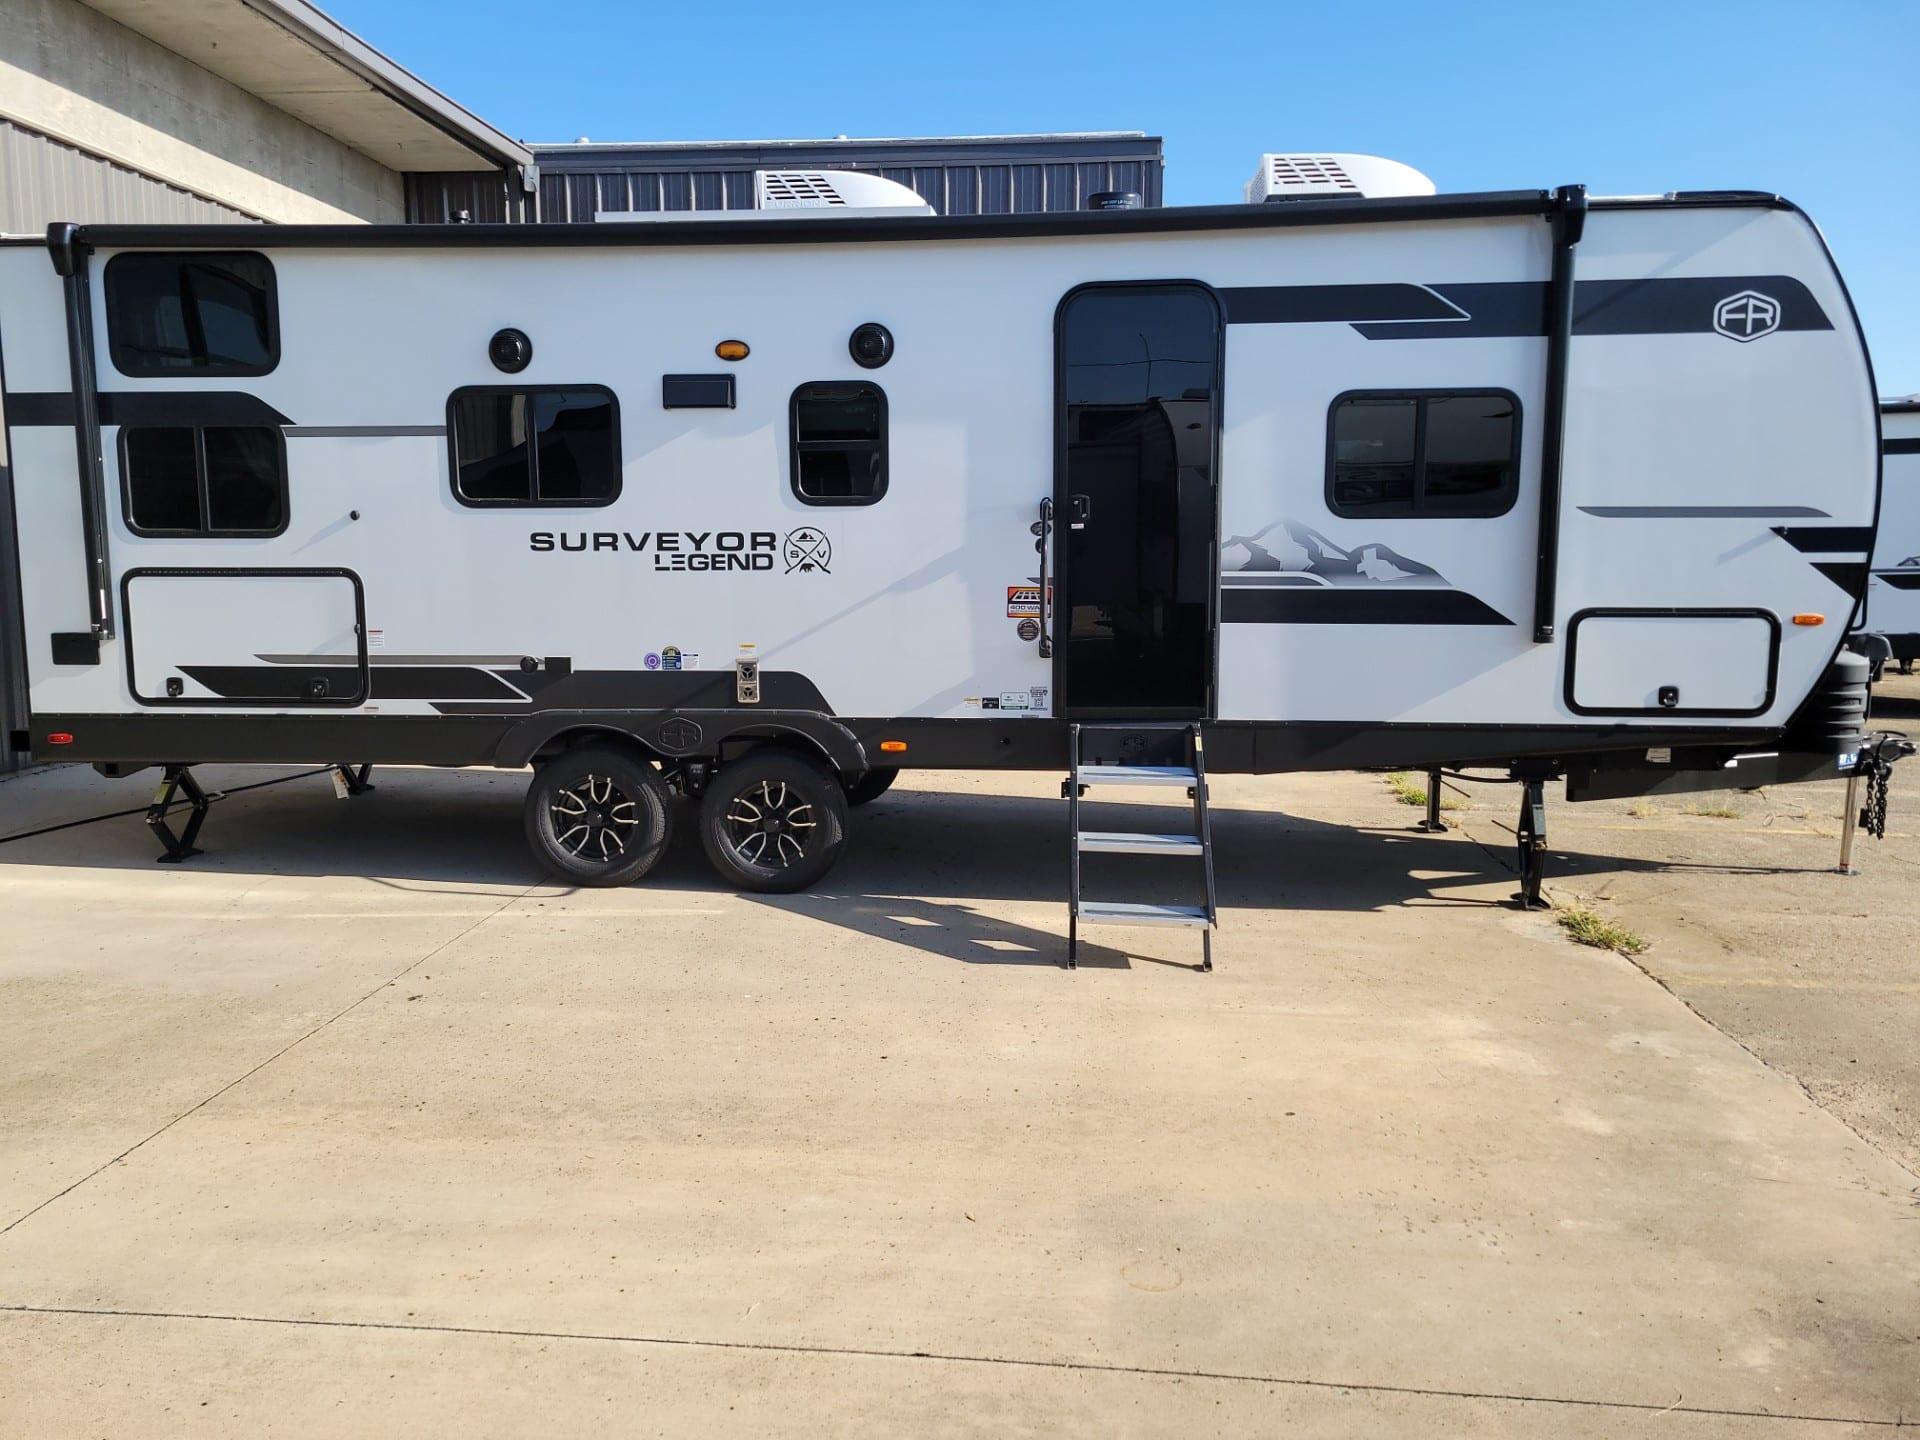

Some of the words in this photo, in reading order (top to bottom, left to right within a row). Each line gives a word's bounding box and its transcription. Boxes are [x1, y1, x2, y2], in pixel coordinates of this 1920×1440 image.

[530, 532, 777, 551] SURVEYOR
[655, 553, 774, 571] LEGEND
[790, 550, 799, 558] S
[817, 550, 827, 558] V
